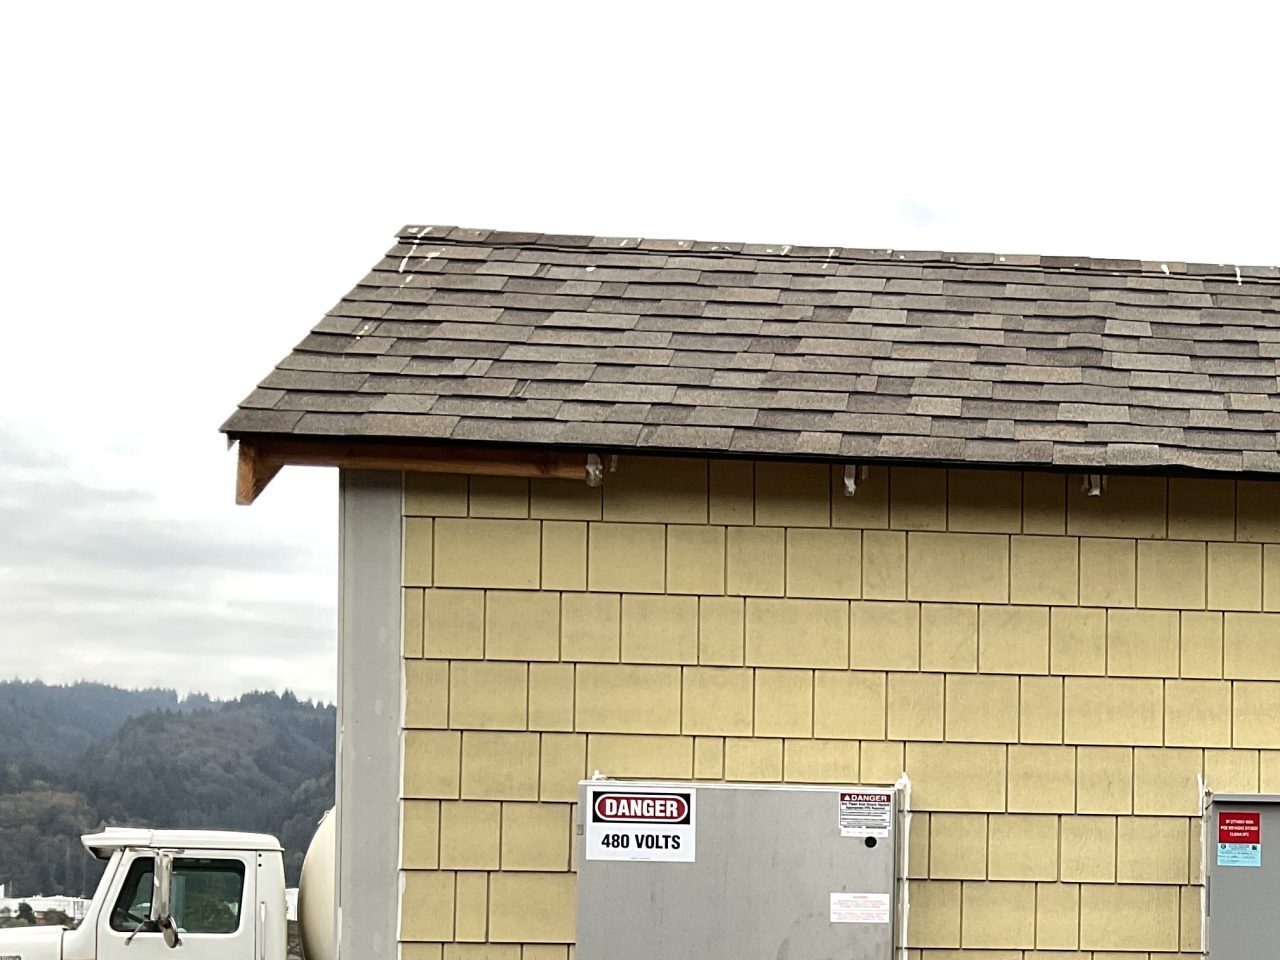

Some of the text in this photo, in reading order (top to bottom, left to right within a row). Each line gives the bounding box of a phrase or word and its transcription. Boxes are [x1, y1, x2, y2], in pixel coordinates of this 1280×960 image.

[605, 798, 678, 817] DANGER
[601, 833, 681, 850] 480 VOLTS
